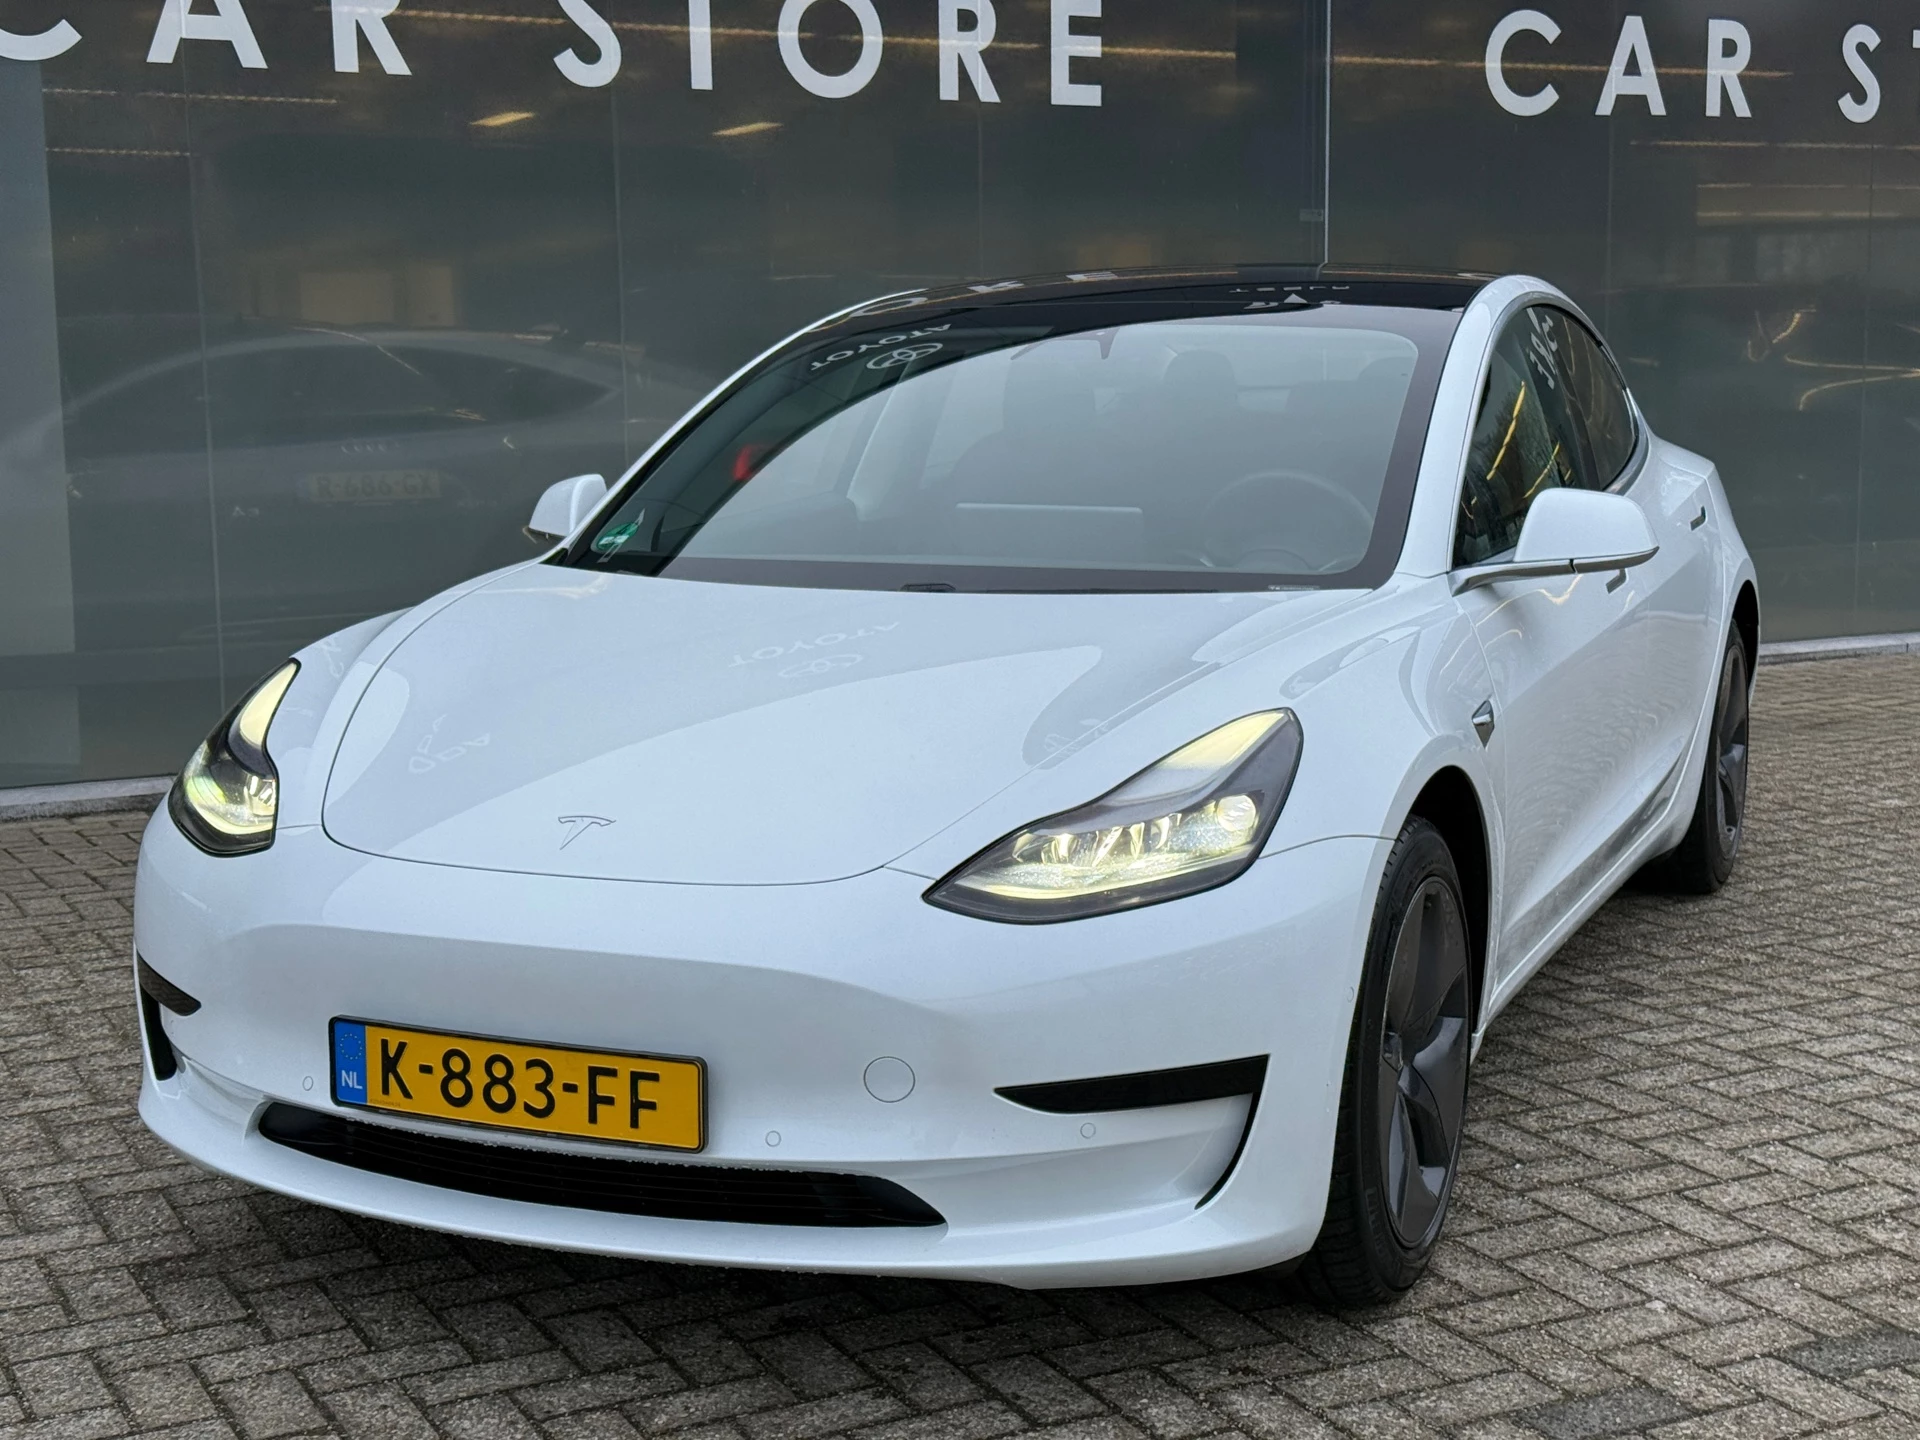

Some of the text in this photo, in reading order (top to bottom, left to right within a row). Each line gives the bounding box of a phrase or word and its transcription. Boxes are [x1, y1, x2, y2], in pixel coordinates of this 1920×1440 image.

[553, 0, 1102, 107] STORE
[1485, 9, 1920, 123] CAR S
[341, 1038, 660, 1129] NL K-883-FF
